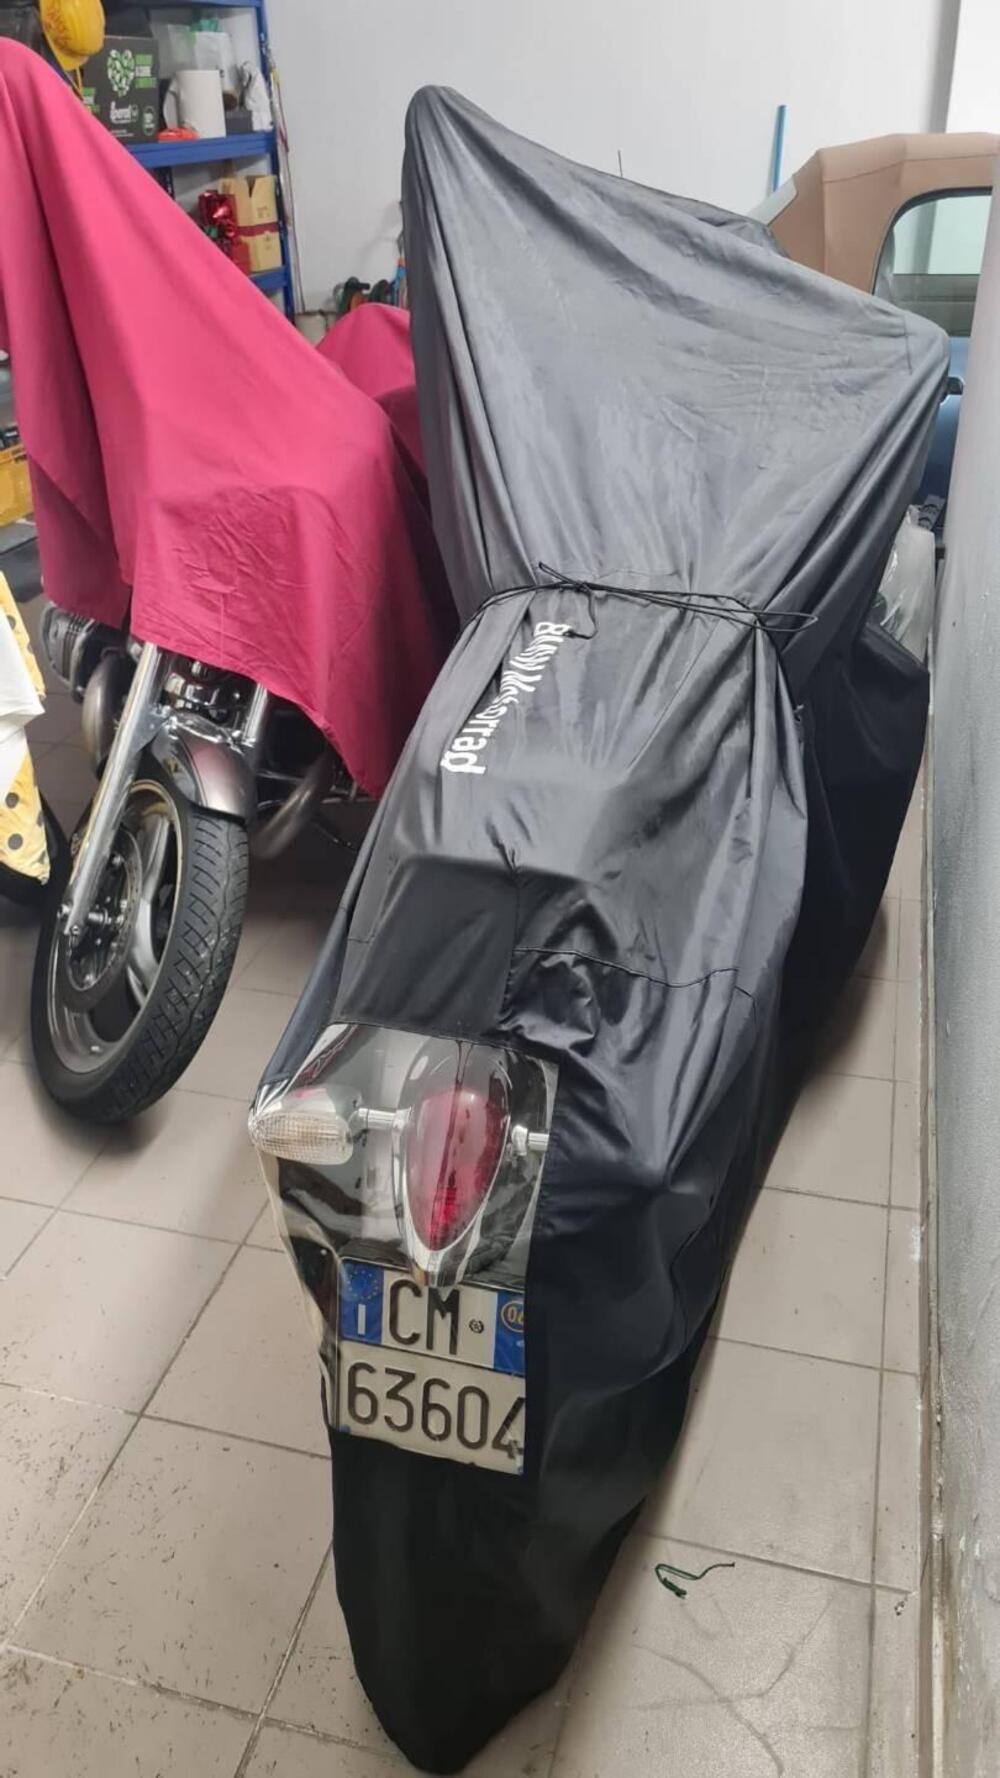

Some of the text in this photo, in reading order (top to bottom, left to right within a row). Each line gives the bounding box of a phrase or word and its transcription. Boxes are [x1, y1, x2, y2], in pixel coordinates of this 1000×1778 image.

[440, 622, 571, 774] BMW Motorrad
[389, 1278, 460, 1355] CM
[347, 1362, 525, 1459] 63604
